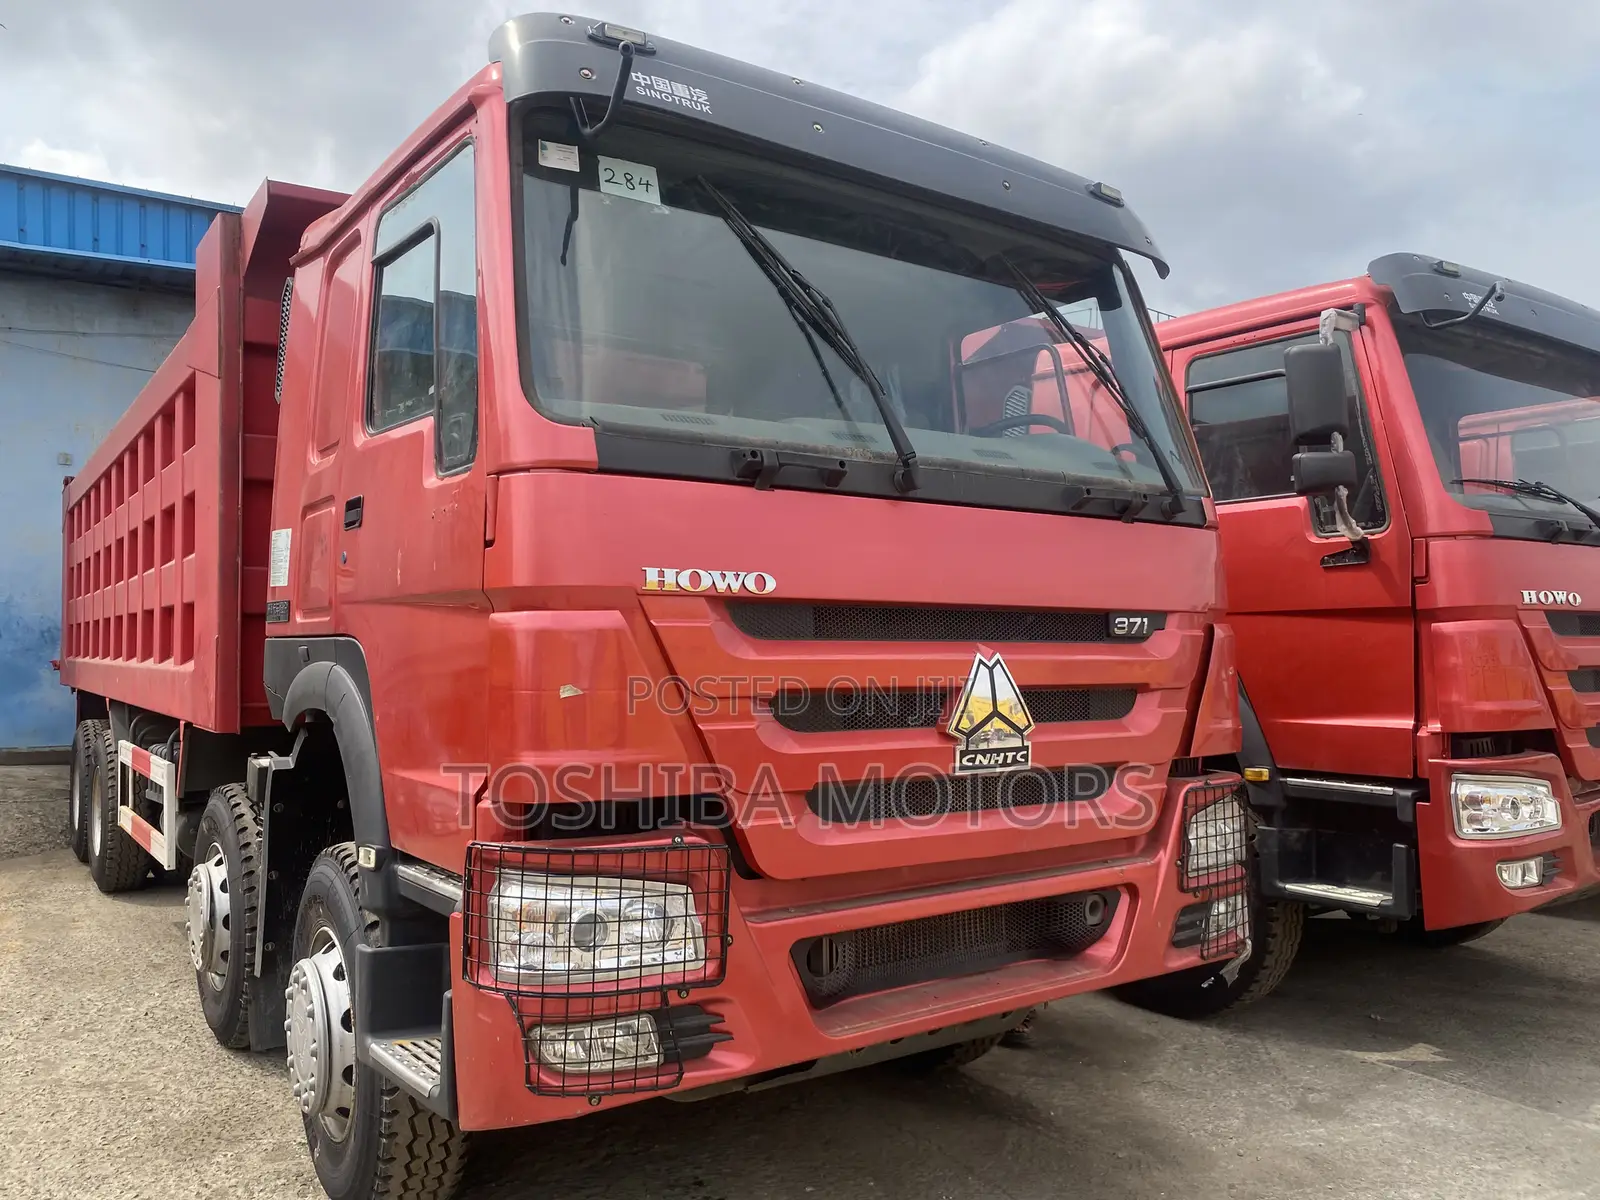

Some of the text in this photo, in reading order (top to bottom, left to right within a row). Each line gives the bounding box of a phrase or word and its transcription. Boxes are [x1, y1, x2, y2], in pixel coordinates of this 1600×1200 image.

[631, 72, 710, 105] 中国重汽
[635, 86, 713, 115] SINOTRUK
[603, 167, 654, 193] 284
[641, 566, 777, 595] HOWO
[1520, 590, 1582, 607] HOWO
[1114, 617, 1148, 635] 371
[961, 750, 1027, 766] CNHTC
